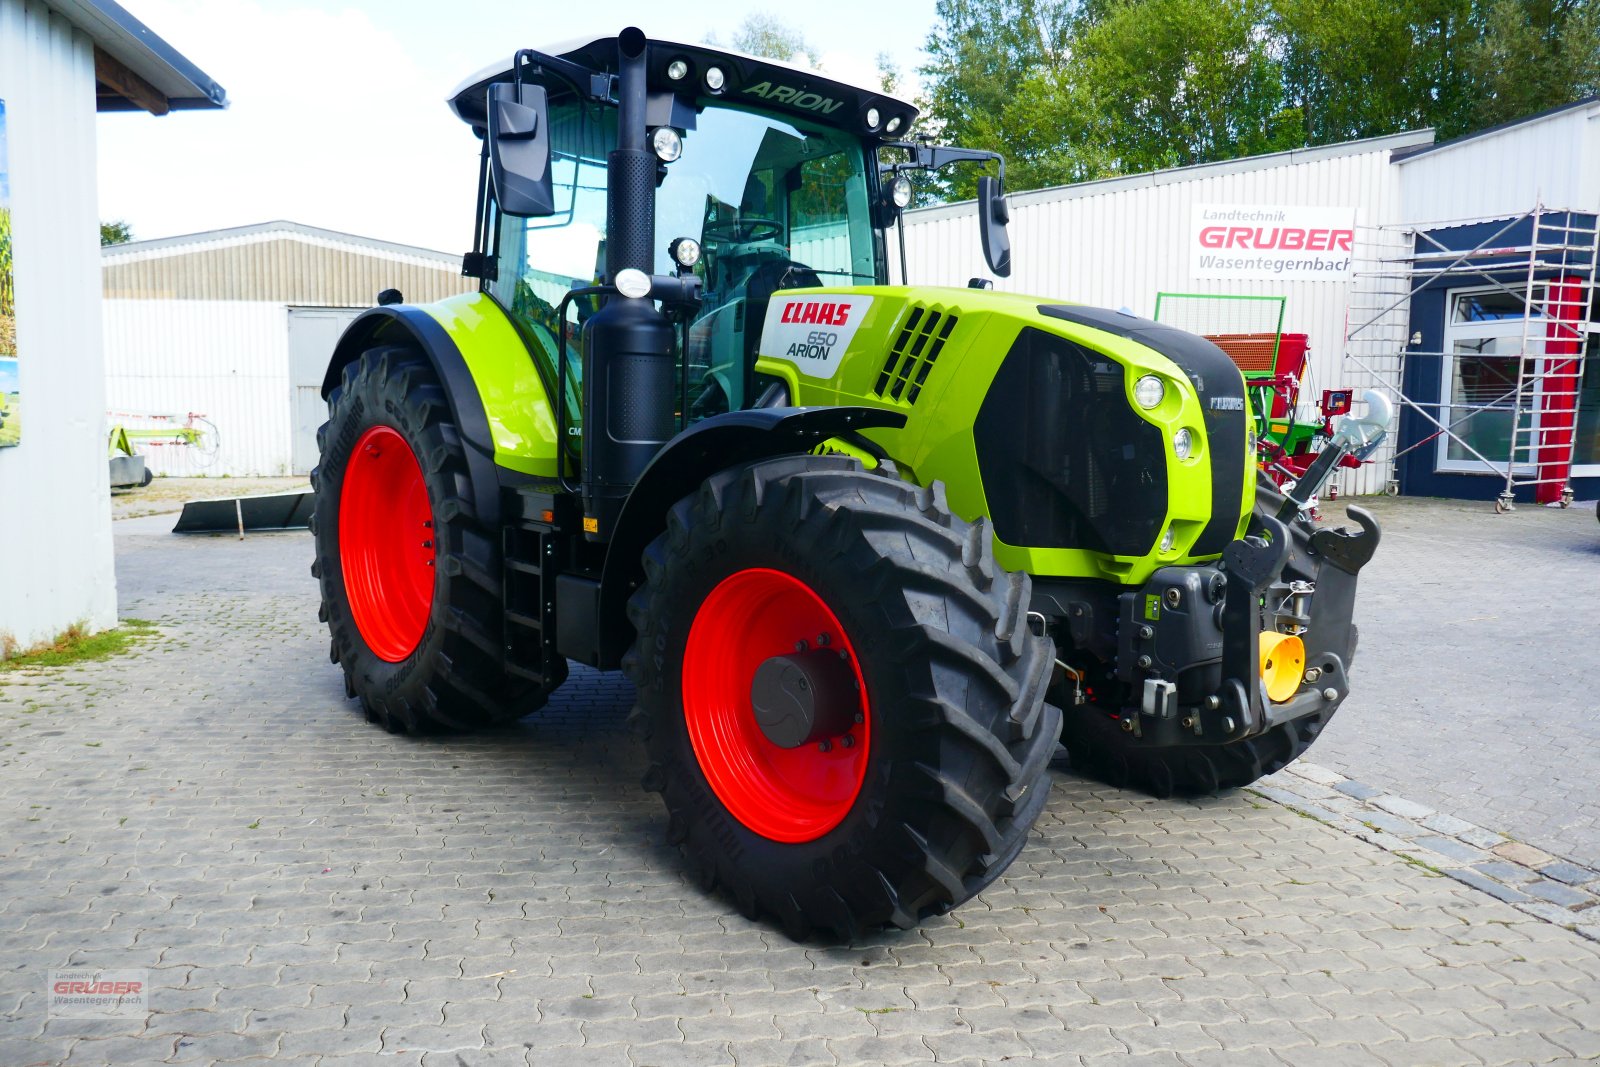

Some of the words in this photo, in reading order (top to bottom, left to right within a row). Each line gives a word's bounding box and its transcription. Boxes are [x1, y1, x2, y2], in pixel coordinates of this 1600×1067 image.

[741, 81, 844, 114] ARION
[1202, 209, 1286, 222] Landtechnik
[1199, 226, 1353, 252] GRUBER
[780, 302, 852, 327] CLAAS
[807, 331, 838, 347] 650
[786, 342, 831, 361] ARION
